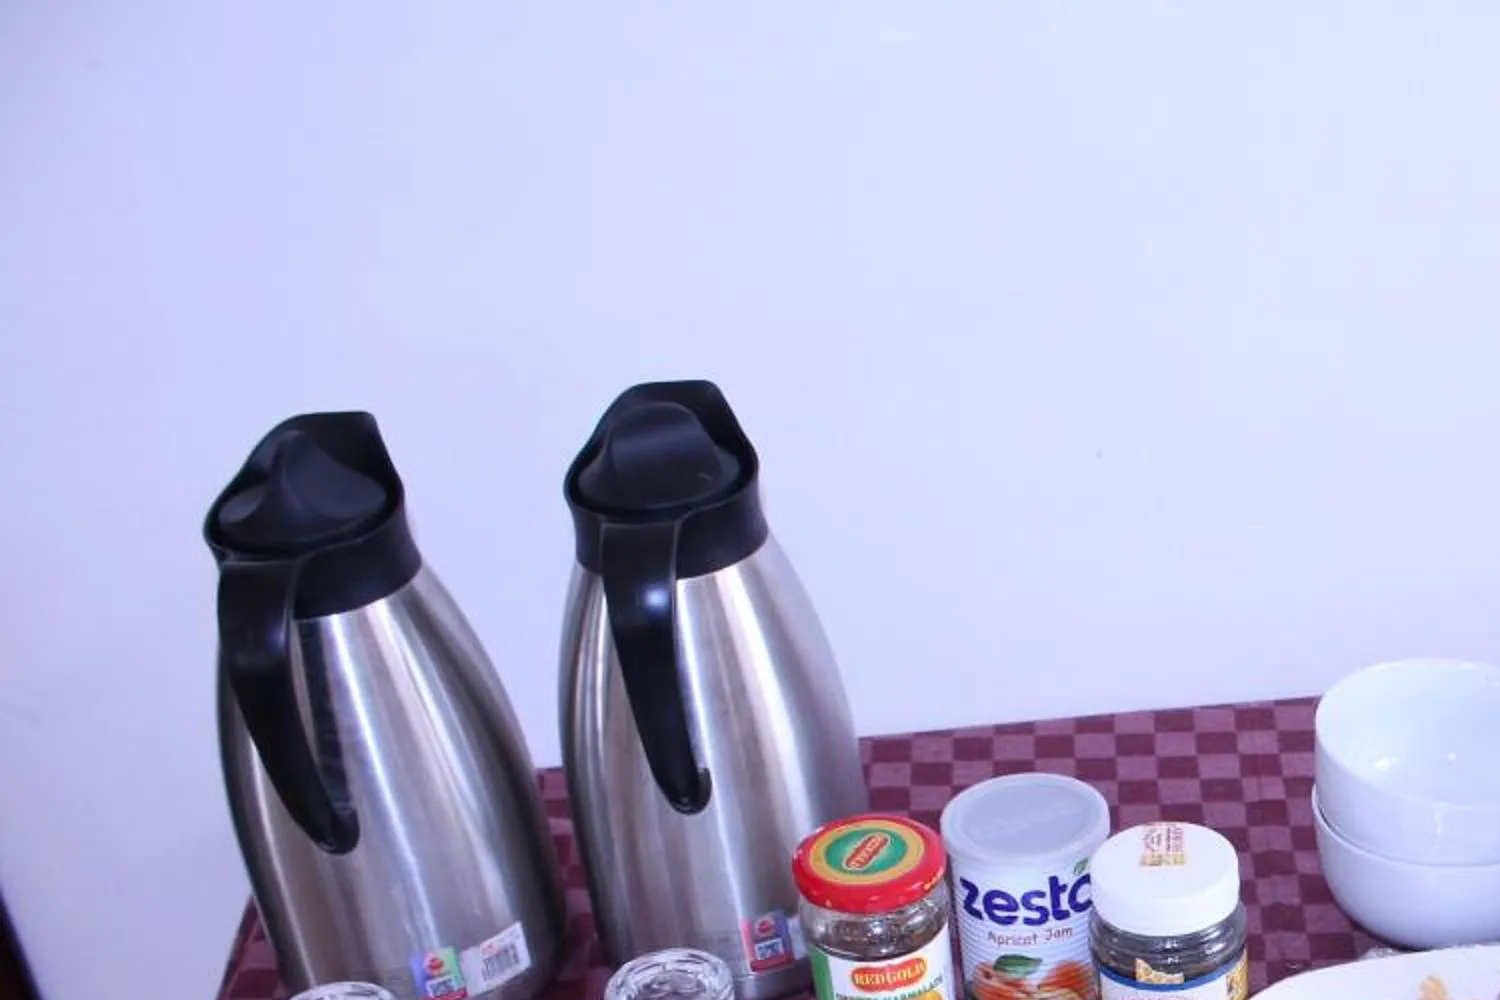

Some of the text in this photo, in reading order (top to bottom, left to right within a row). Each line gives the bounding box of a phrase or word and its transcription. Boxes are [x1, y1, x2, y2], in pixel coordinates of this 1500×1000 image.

[988, 927, 1073, 947] Apricot Jam
[854, 960, 926, 986] REDGOLD
